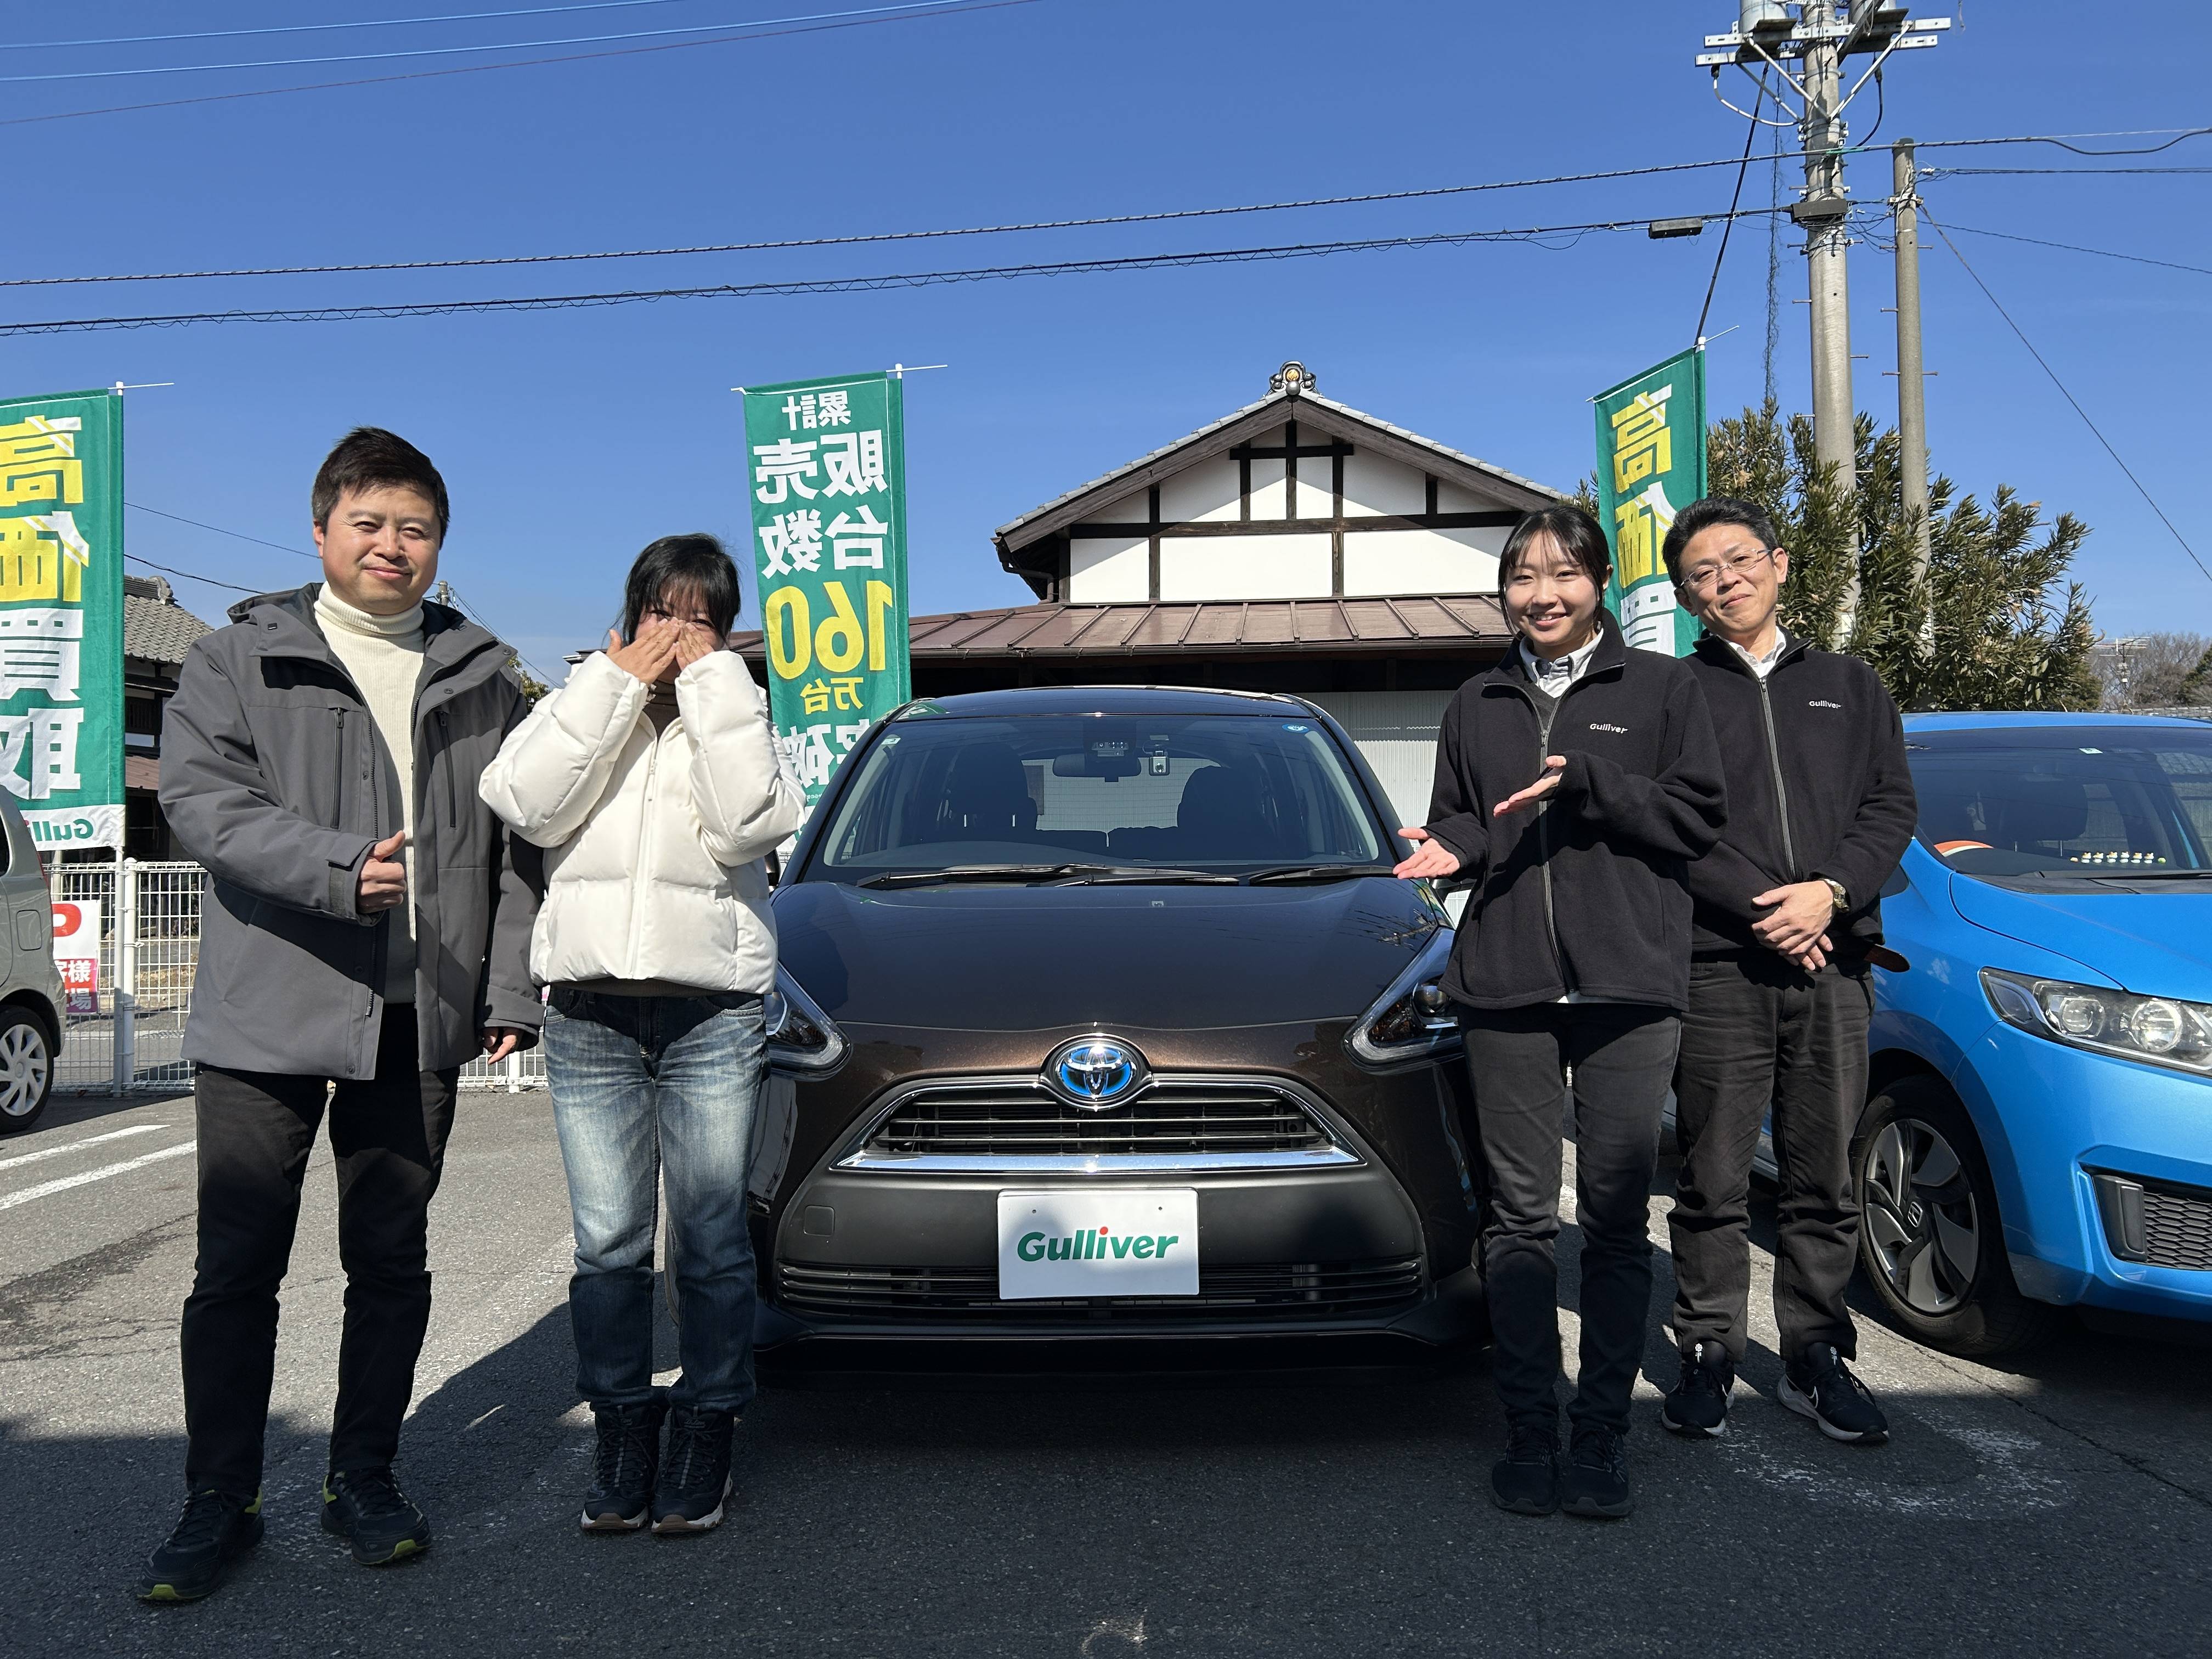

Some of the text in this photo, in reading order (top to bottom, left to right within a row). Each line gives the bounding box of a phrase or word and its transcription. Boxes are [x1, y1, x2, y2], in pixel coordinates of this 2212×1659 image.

[1809, 700, 1841, 709] Gulliver
[1590, 723, 1628, 734] Gulliver
[1017, 1226, 1179, 1262] Gulliver
